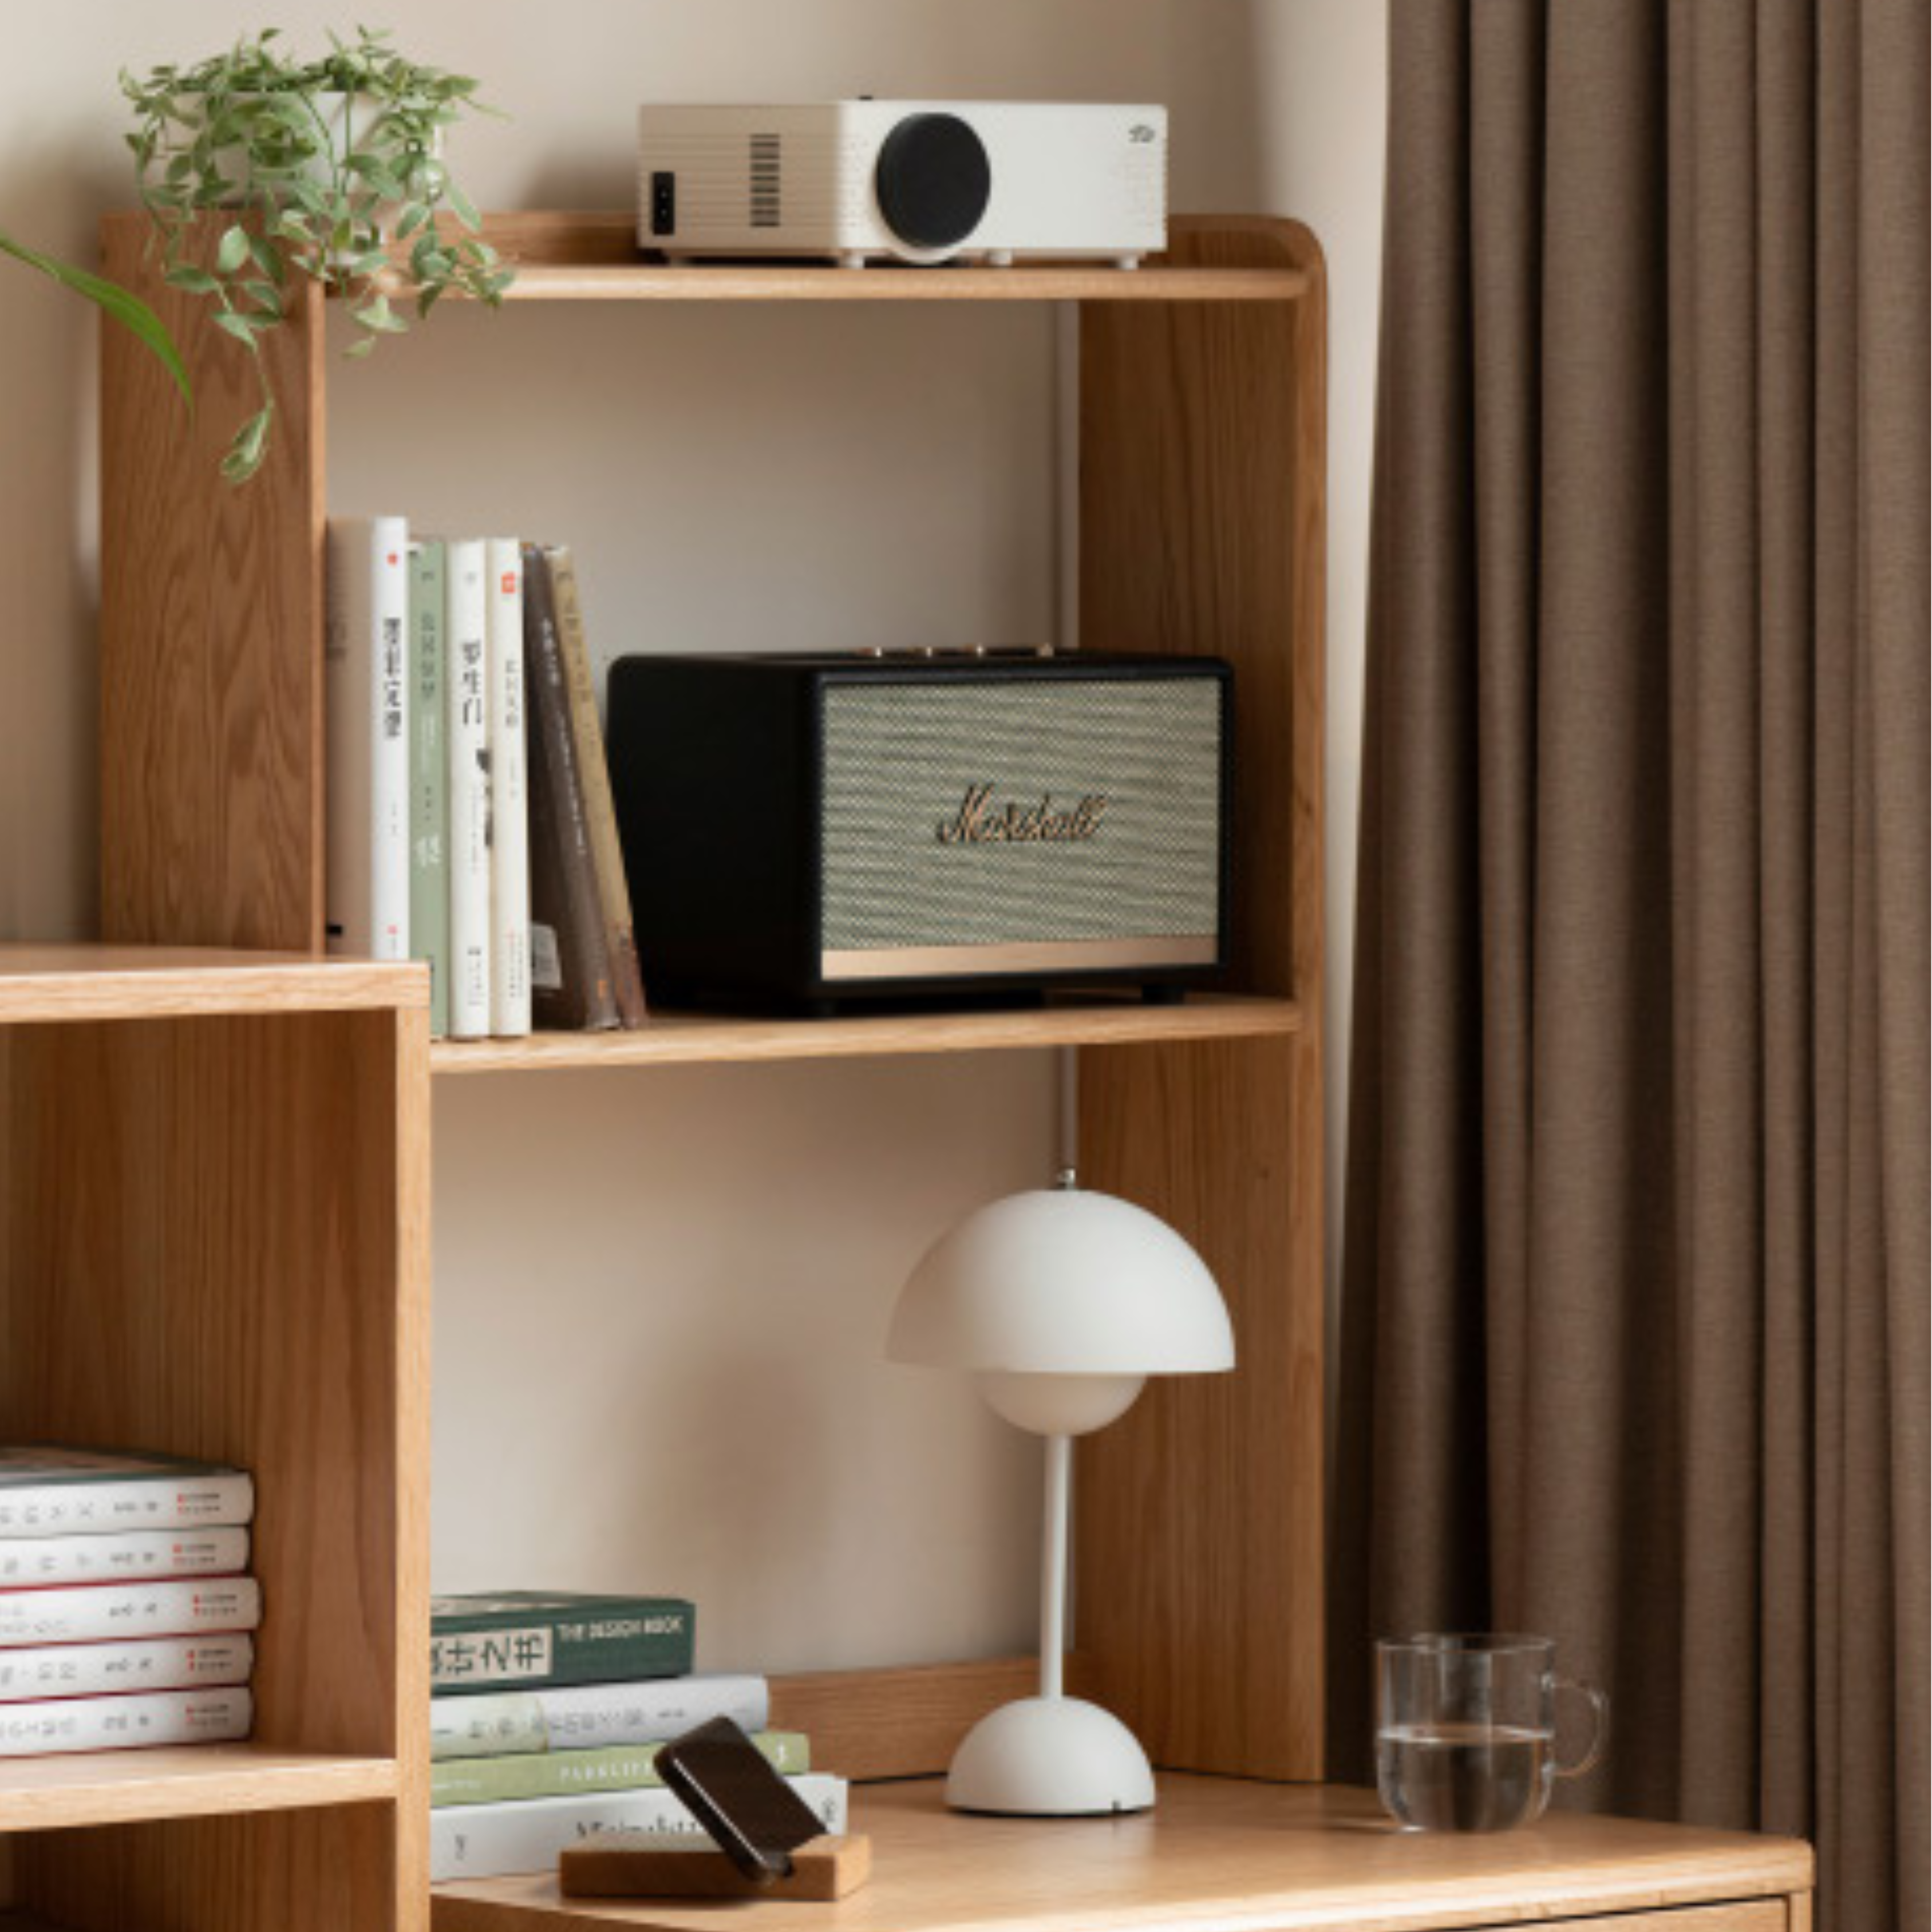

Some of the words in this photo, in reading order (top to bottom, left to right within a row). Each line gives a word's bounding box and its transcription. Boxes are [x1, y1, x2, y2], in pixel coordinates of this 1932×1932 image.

[937, 780, 1108, 844] Marshall
[556, 1621, 585, 1642] THE
[643, 1615, 685, 1635] BOOK
